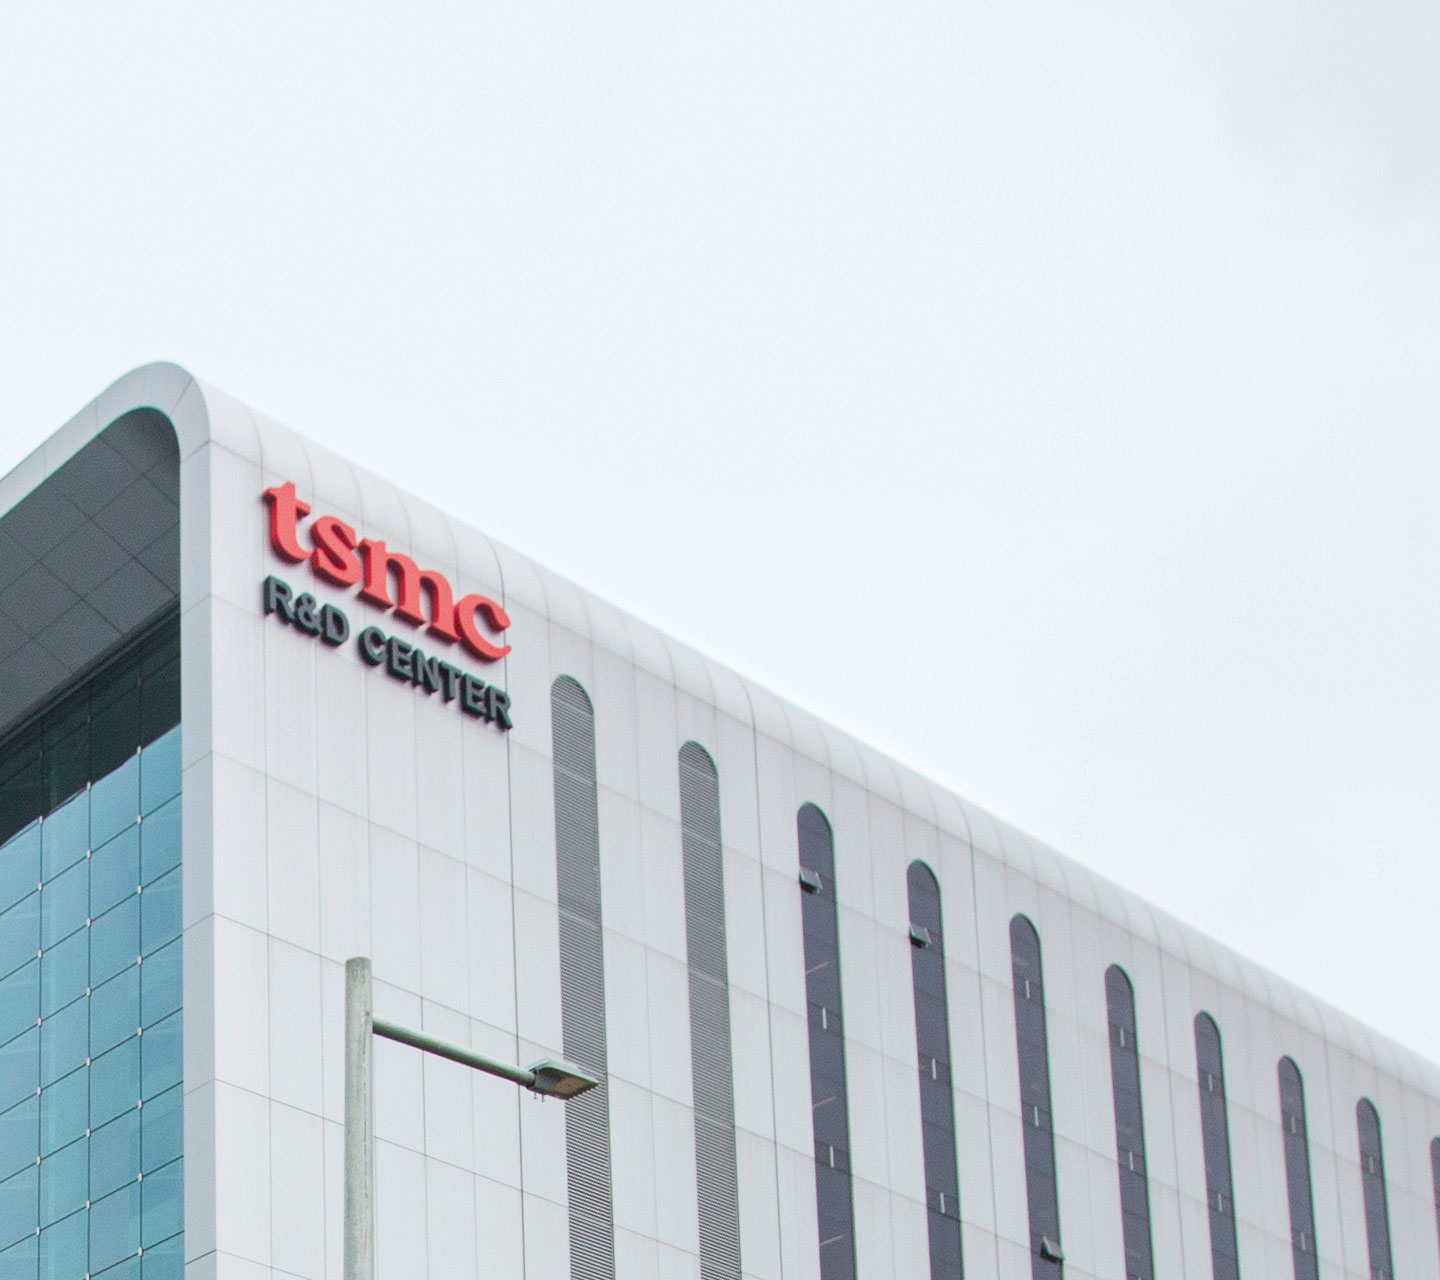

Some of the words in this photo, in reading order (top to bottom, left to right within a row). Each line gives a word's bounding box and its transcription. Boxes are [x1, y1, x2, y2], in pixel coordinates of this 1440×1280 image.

[262, 481, 512, 661] tsmc
[263, 574, 350, 647] R&D
[358, 626, 514, 731] CENTER
